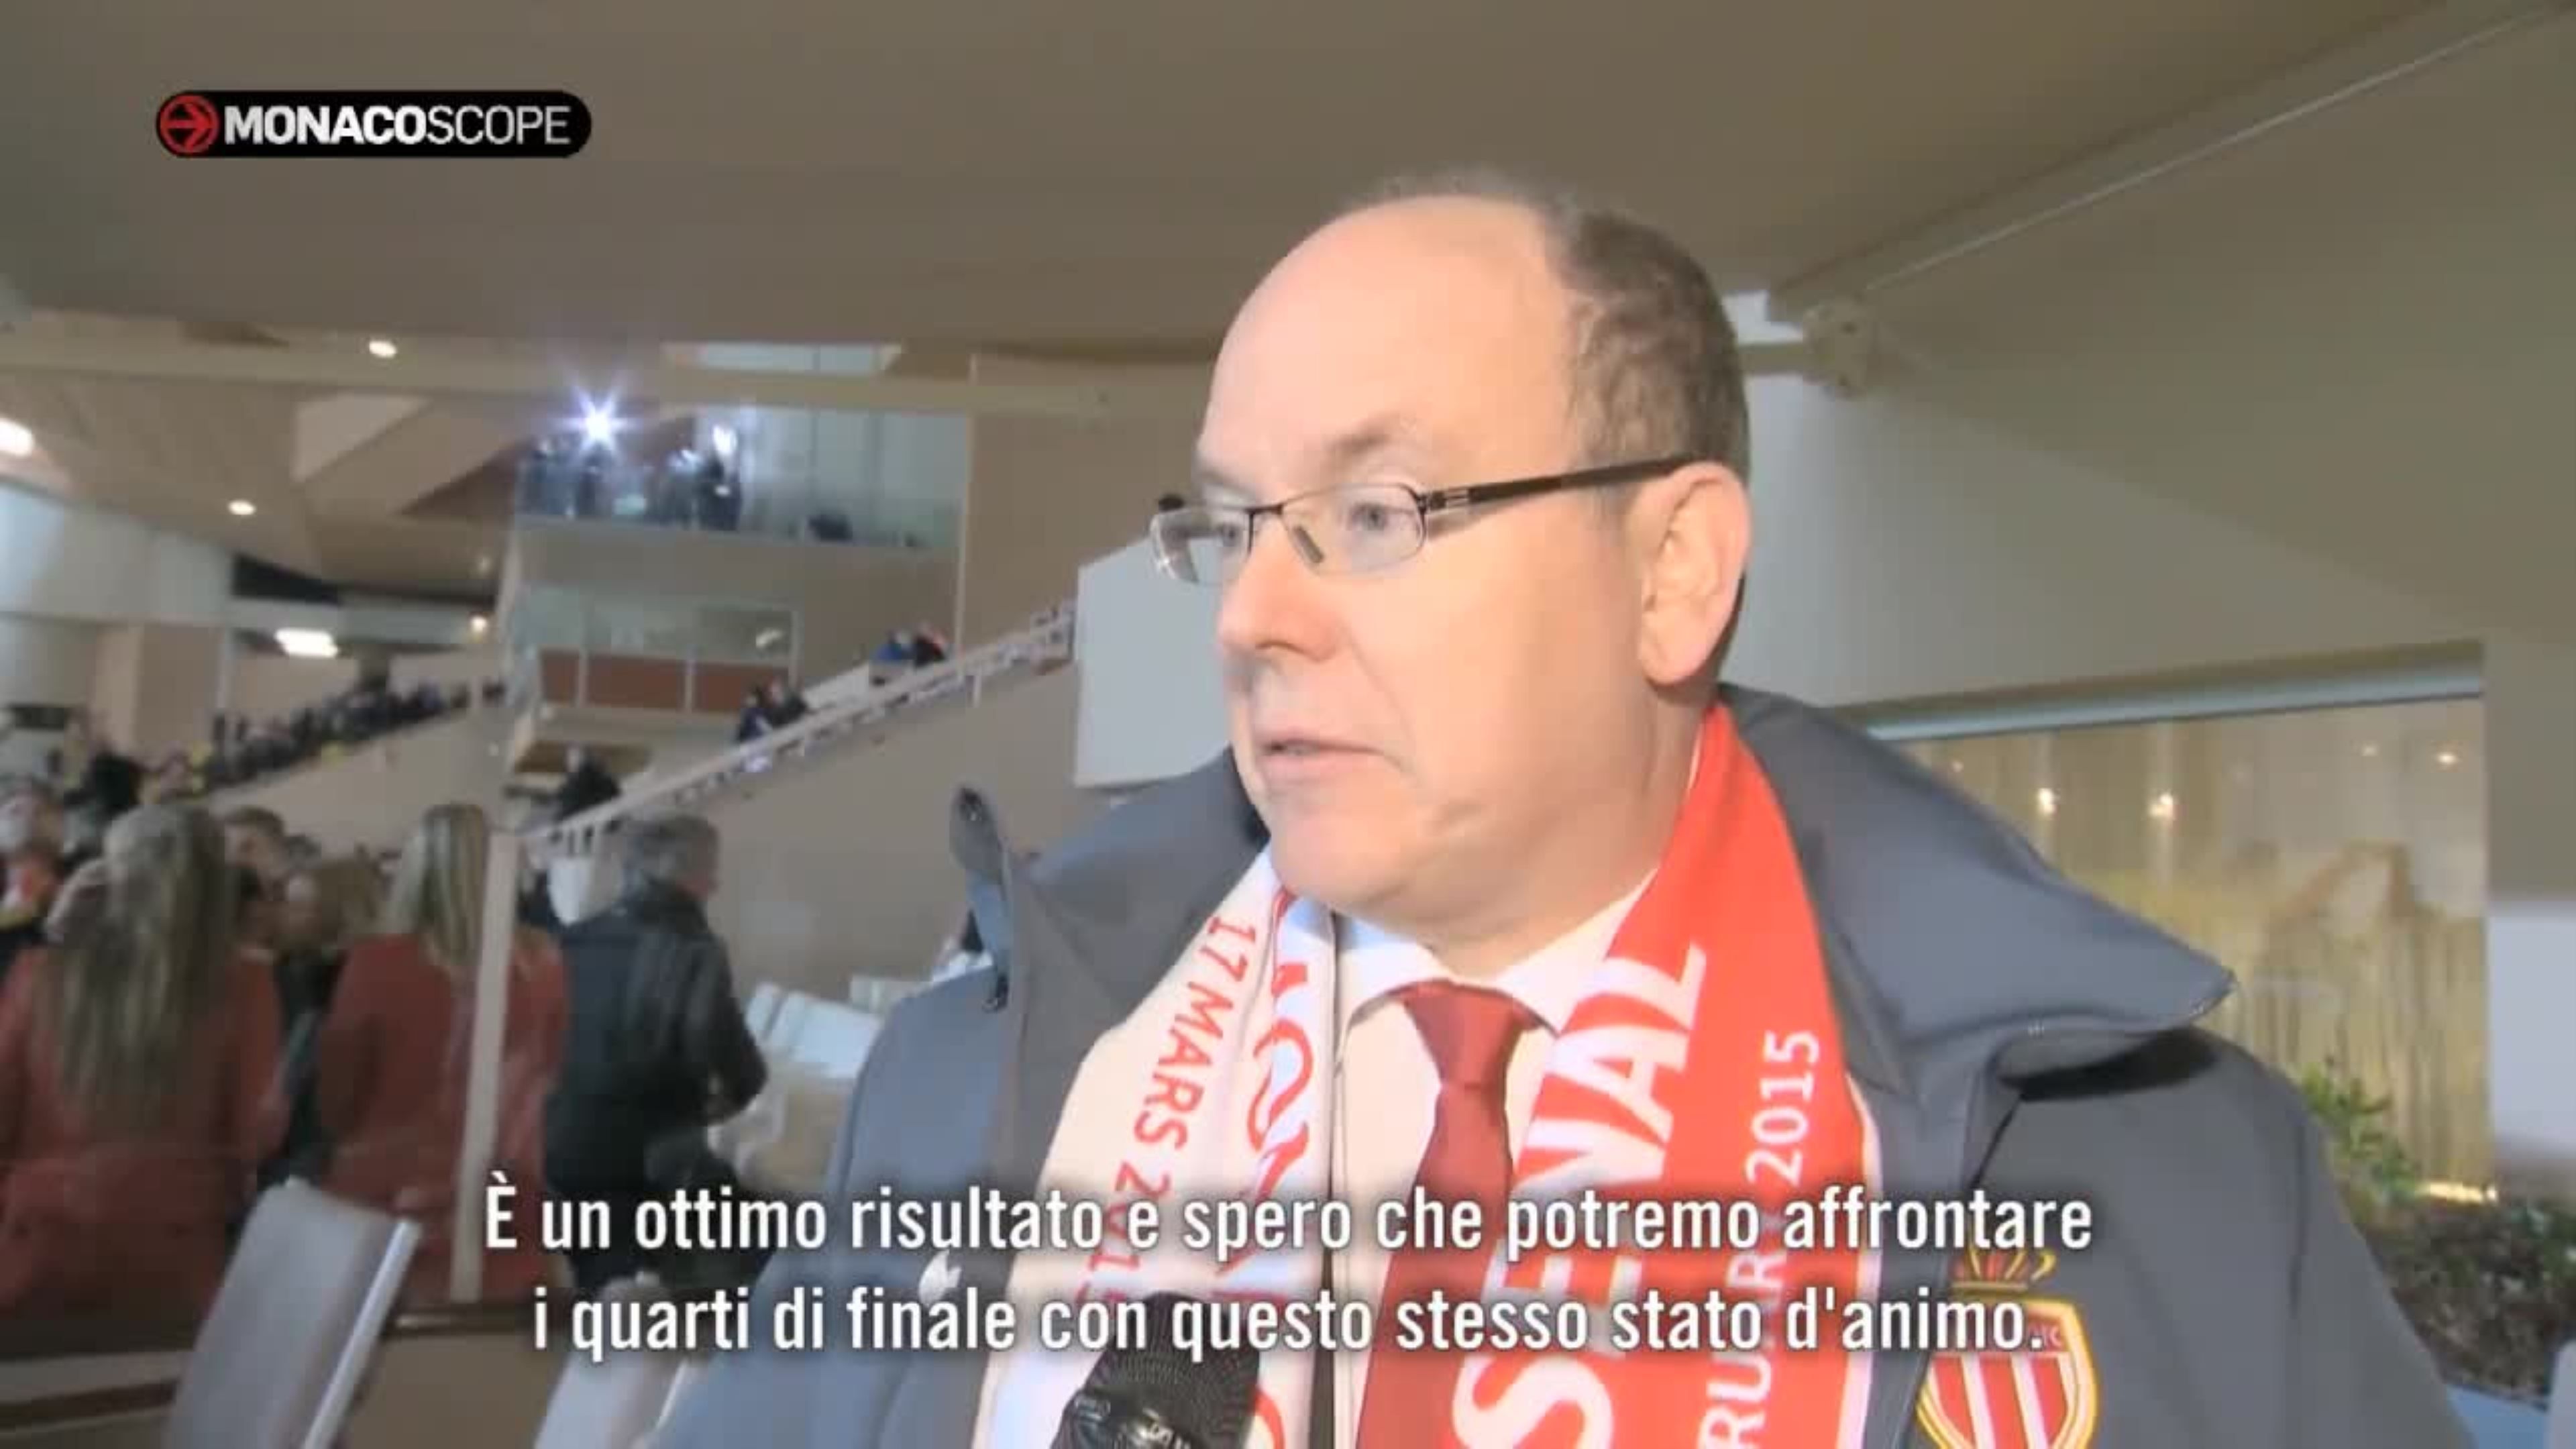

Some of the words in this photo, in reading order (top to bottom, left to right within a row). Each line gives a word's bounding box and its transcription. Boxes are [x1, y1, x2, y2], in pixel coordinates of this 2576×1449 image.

[1194, 914, 1258, 983] 17
[1132, 981, 1236, 1151] MARS
[1744, 1030, 1821, 1187] 2015
